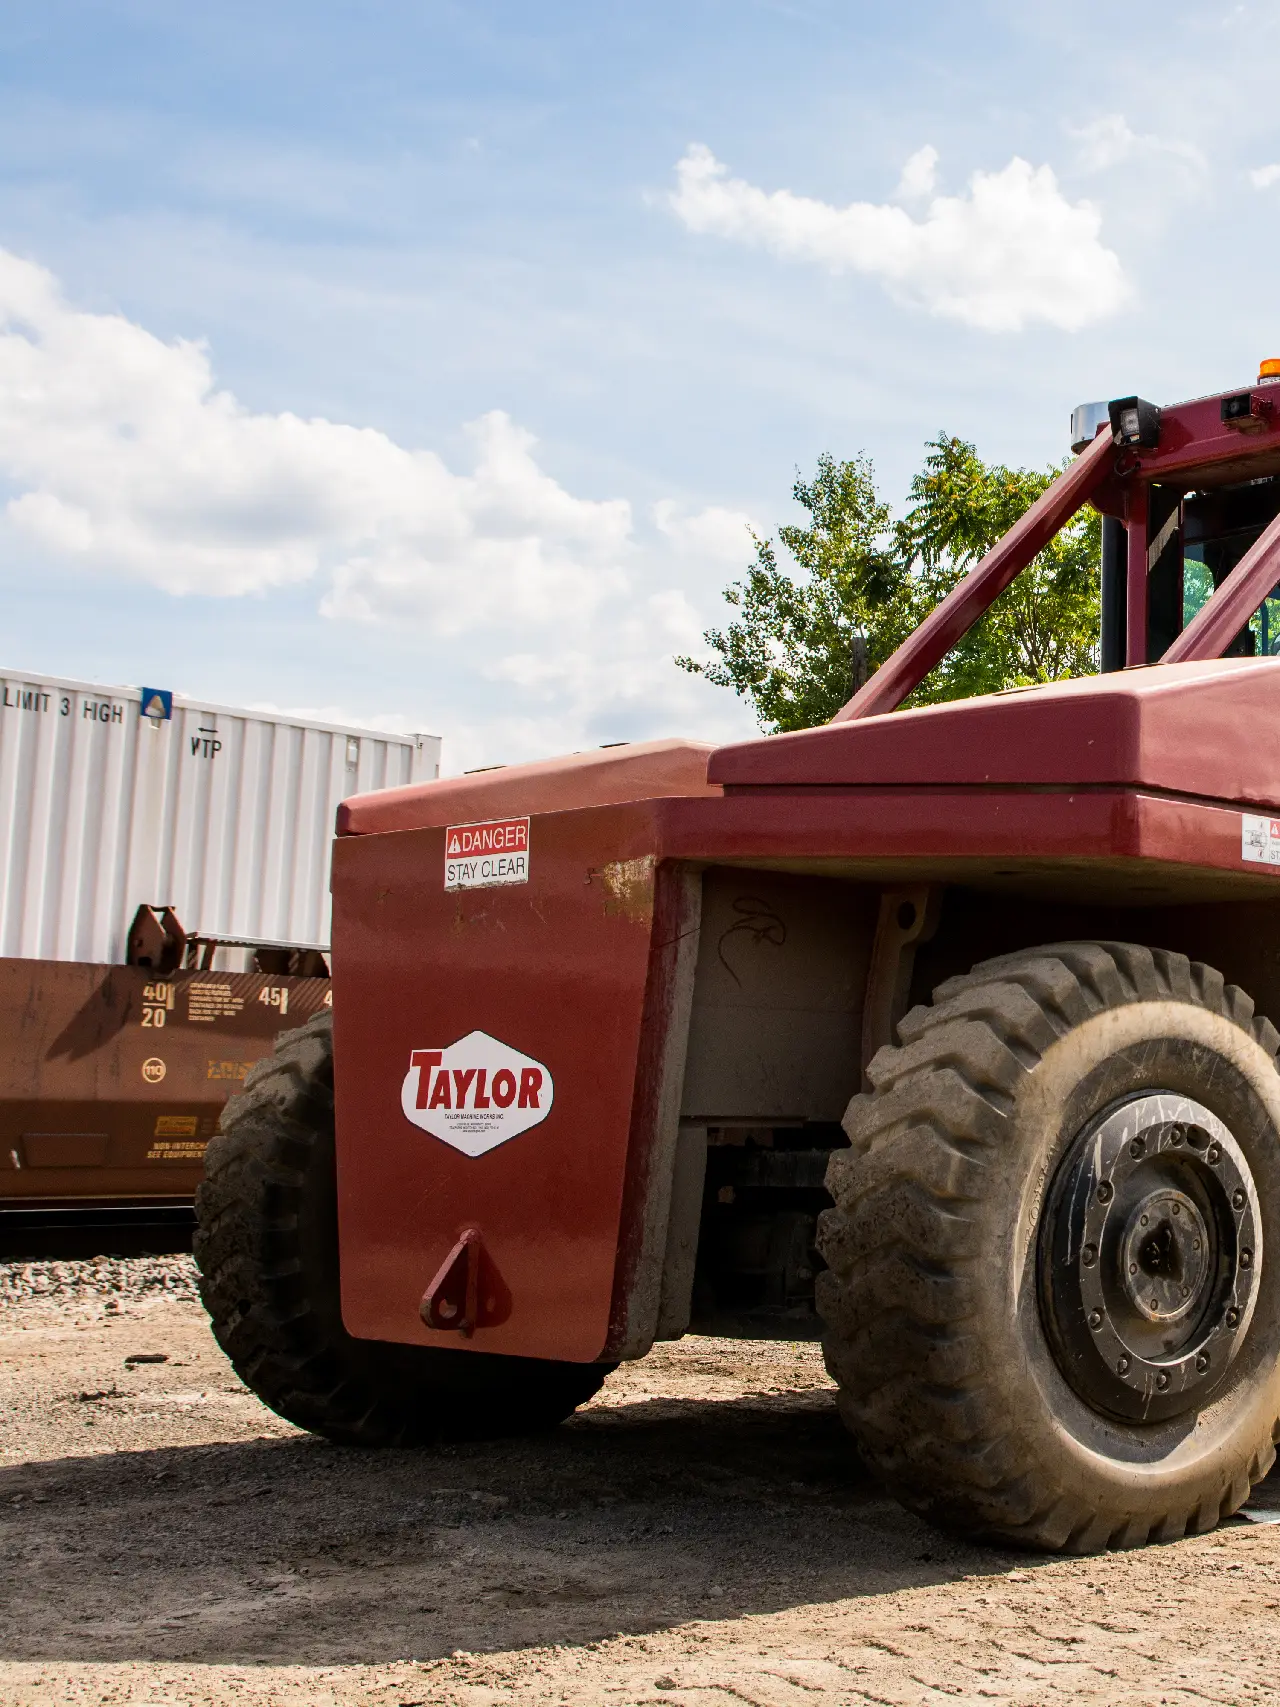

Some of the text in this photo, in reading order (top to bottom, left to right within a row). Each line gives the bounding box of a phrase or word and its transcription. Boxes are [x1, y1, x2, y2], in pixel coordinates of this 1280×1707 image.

[3, 686, 124, 724] LIMIT 3 HIGH
[191, 736, 222, 760] VTP
[462, 825, 526, 852] DANGER
[447, 856, 525, 881] STAY CLEAR
[142, 982, 167, 1001] 40
[258, 986, 280, 1006] 45
[140, 1008, 166, 1028] 20
[412, 1051, 543, 1110] TAYLOR
